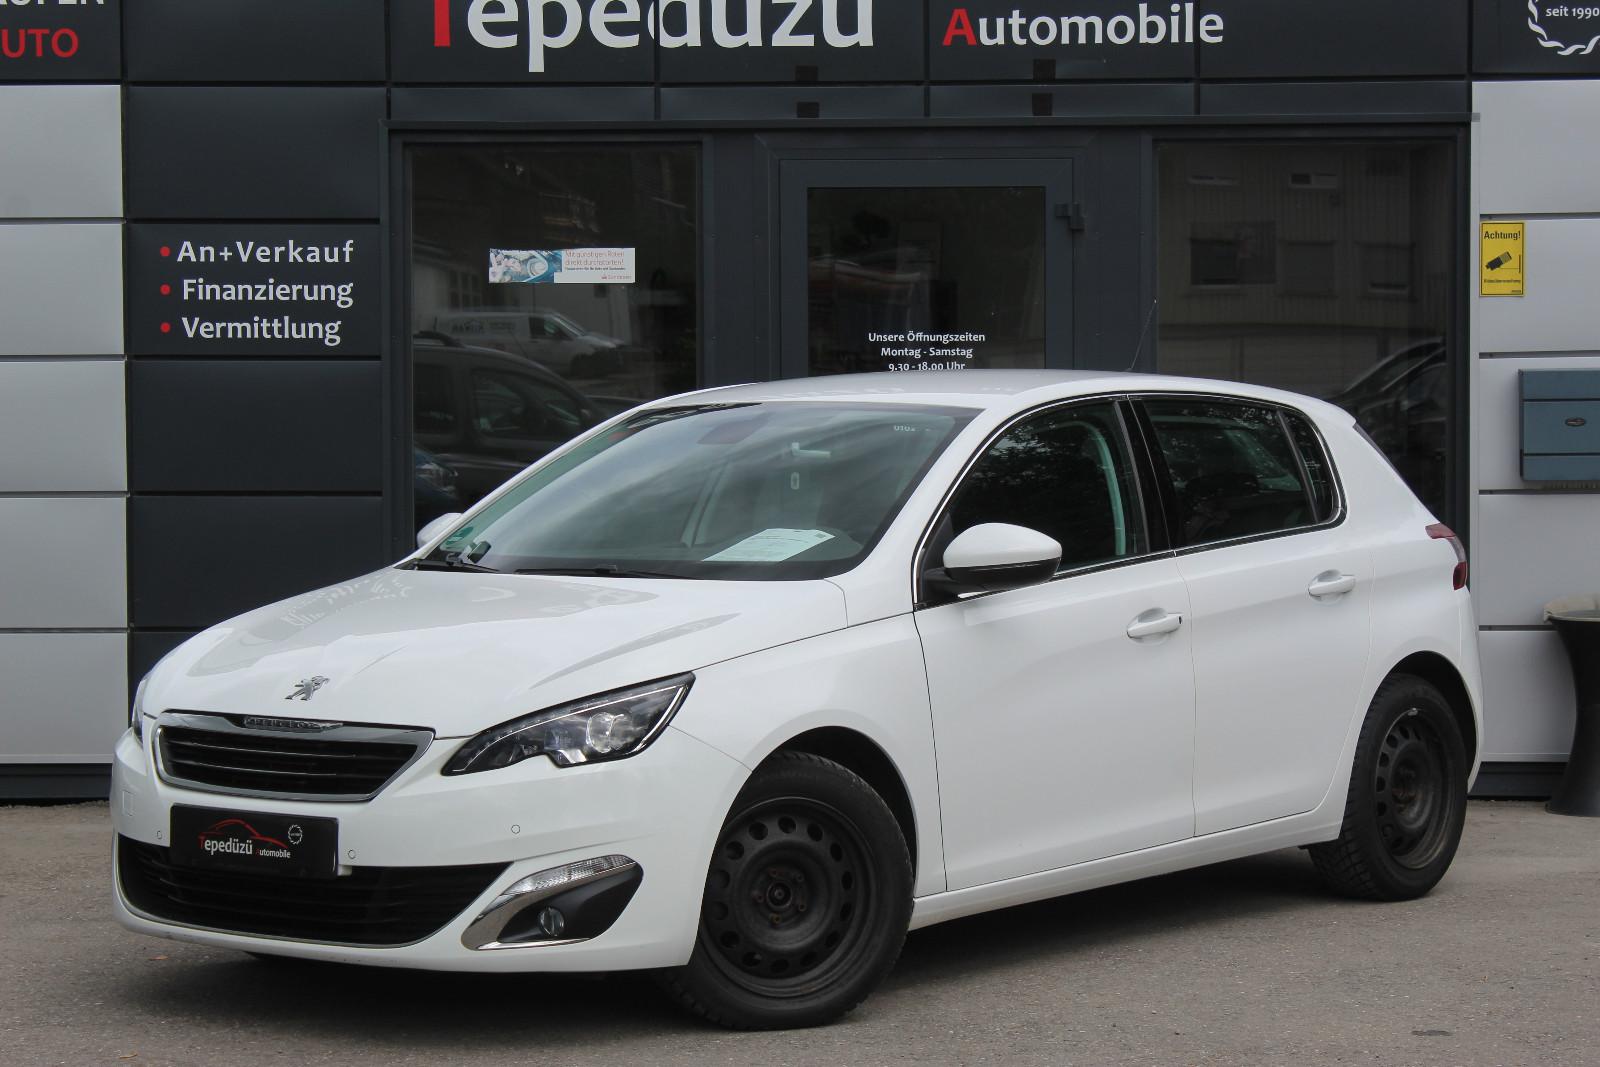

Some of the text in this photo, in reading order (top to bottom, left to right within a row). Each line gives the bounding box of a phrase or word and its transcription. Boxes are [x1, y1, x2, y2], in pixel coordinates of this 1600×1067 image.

[1545, 5, 1600, 20] seit 1990
[942, 2, 1224, 46] Automobile
[1483, 230, 1521, 241] Achtung!
[176, 239, 354, 263] An+Verkauf
[183, 277, 354, 308] Finanzierung
[181, 315, 342, 346] Vermittlung
[868, 330, 986, 344] Unsere Öffnungszeiten
[881, 347, 922, 359] Montag
[929, 347, 974, 359] Samstag
[888, 362, 910, 372] 9.30
[918, 361, 944, 371] 18.00
[946, 361, 966, 370] Uhr
